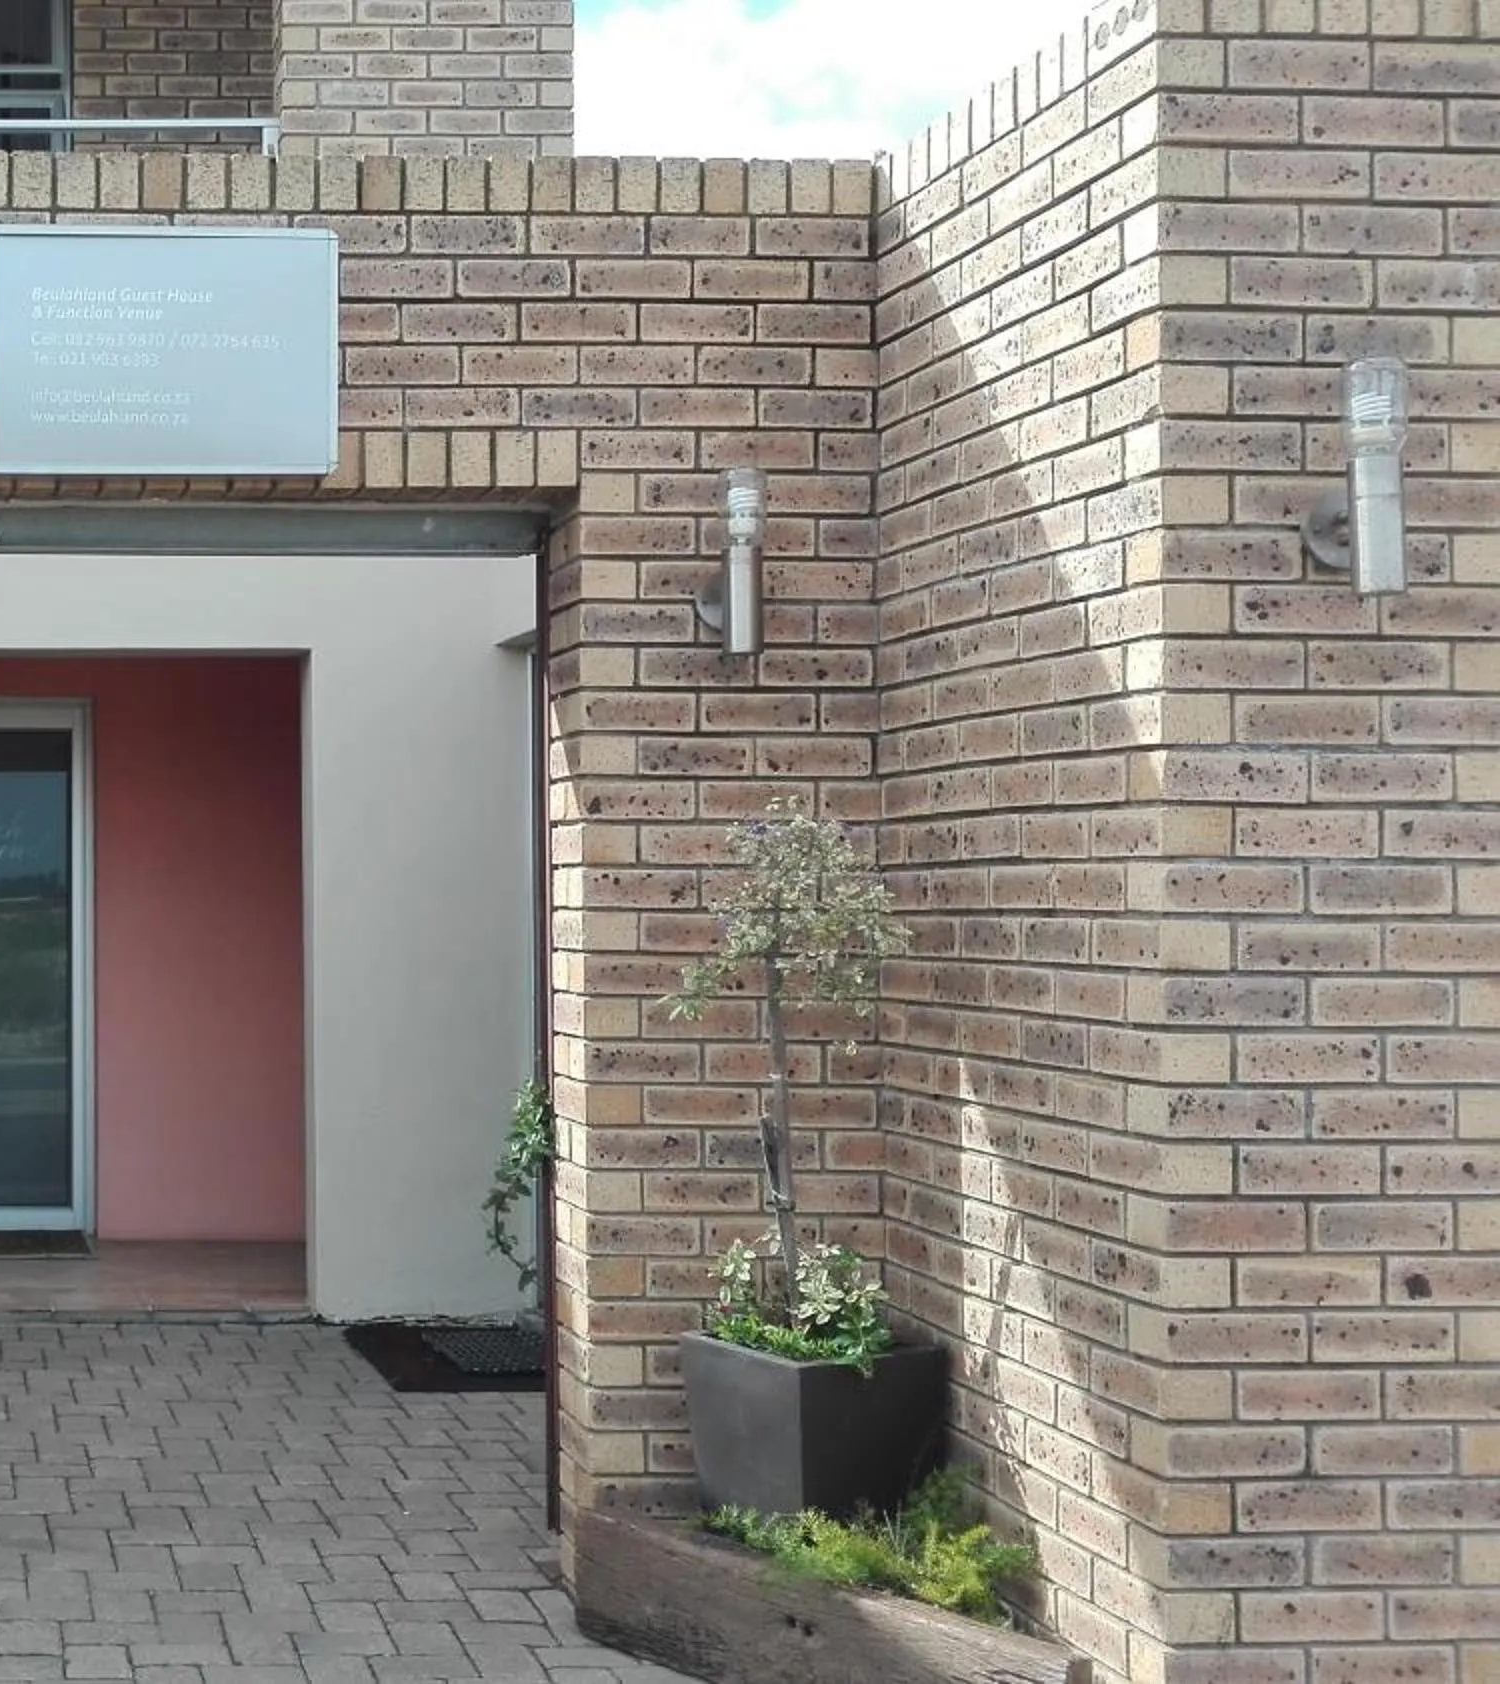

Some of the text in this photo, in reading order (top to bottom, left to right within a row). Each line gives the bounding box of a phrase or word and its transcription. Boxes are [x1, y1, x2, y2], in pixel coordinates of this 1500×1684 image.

[120, 287, 164, 302] Guest
[167, 288, 213, 303] House
[47, 304, 113, 320] Function
[117, 306, 163, 320] Venue
